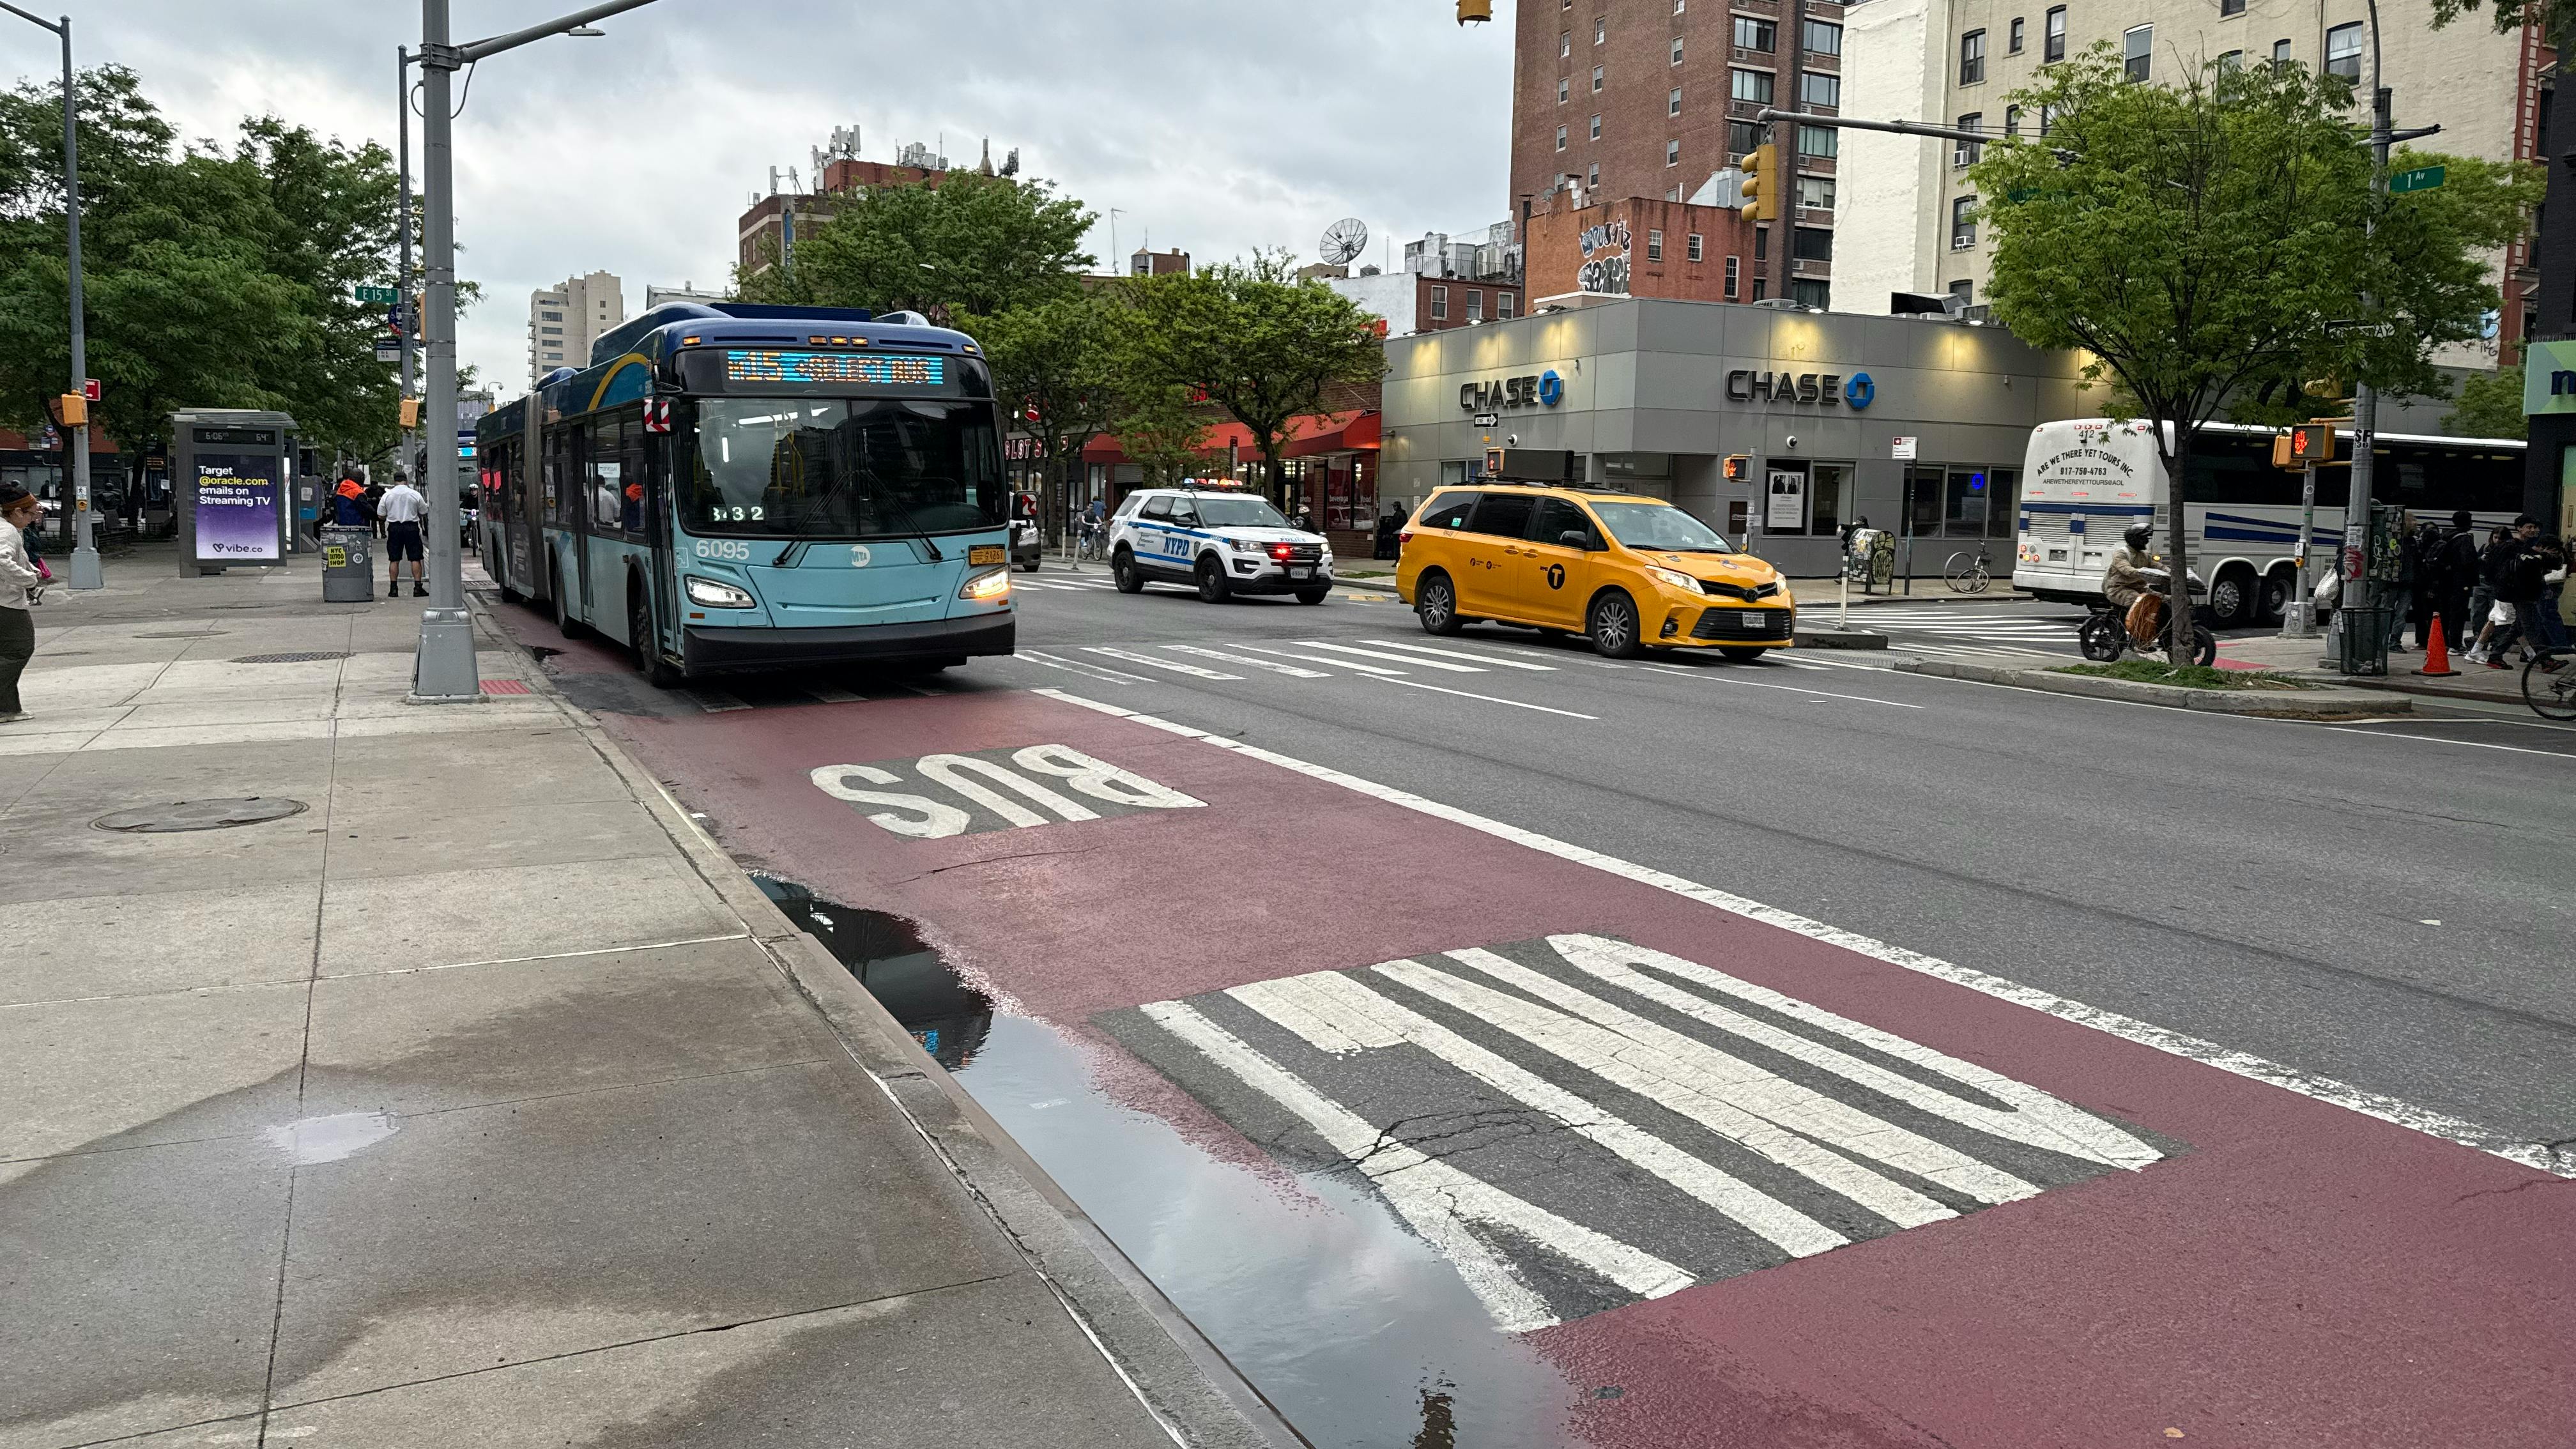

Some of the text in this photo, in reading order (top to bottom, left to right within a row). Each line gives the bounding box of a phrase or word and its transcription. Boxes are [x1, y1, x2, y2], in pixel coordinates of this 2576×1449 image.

[2407, 172, 2425, 188] 1 Av
[363, 289, 368, 300] E
[372, 289, 382, 300] 15
[891, 358, 929, 383] BUS
[1460, 375, 1537, 409] CHASE
[1728, 370, 1841, 402] CHASE
[2079, 430, 2095, 438] 412
[2355, 429, 2371, 441] SF
[2037, 462, 2050, 477] ARE
[2050, 455, 2060, 466] WE
[2061, 448, 2083, 461] THERE
[2085, 449, 2097, 457] YET
[2099, 450, 2122, 467] TOURS
[198, 466, 233, 477] Target
[2060, 467, 2106, 475] 917-750-4763
[199, 476, 268, 486] @oracle.com
[199, 486, 233, 495] emails
[199, 496, 271, 507] Streaming TV
[226, 544, 263, 553] vibe.co
[696, 539, 749, 560] 6095
[1163, 537, 1190, 556] NYPD
[850, 551, 868, 562] MTA
[1552, 567, 1562, 586] T
[810, 744, 1210, 839] BUS
[1139, 933, 2165, 1332] ONLY
